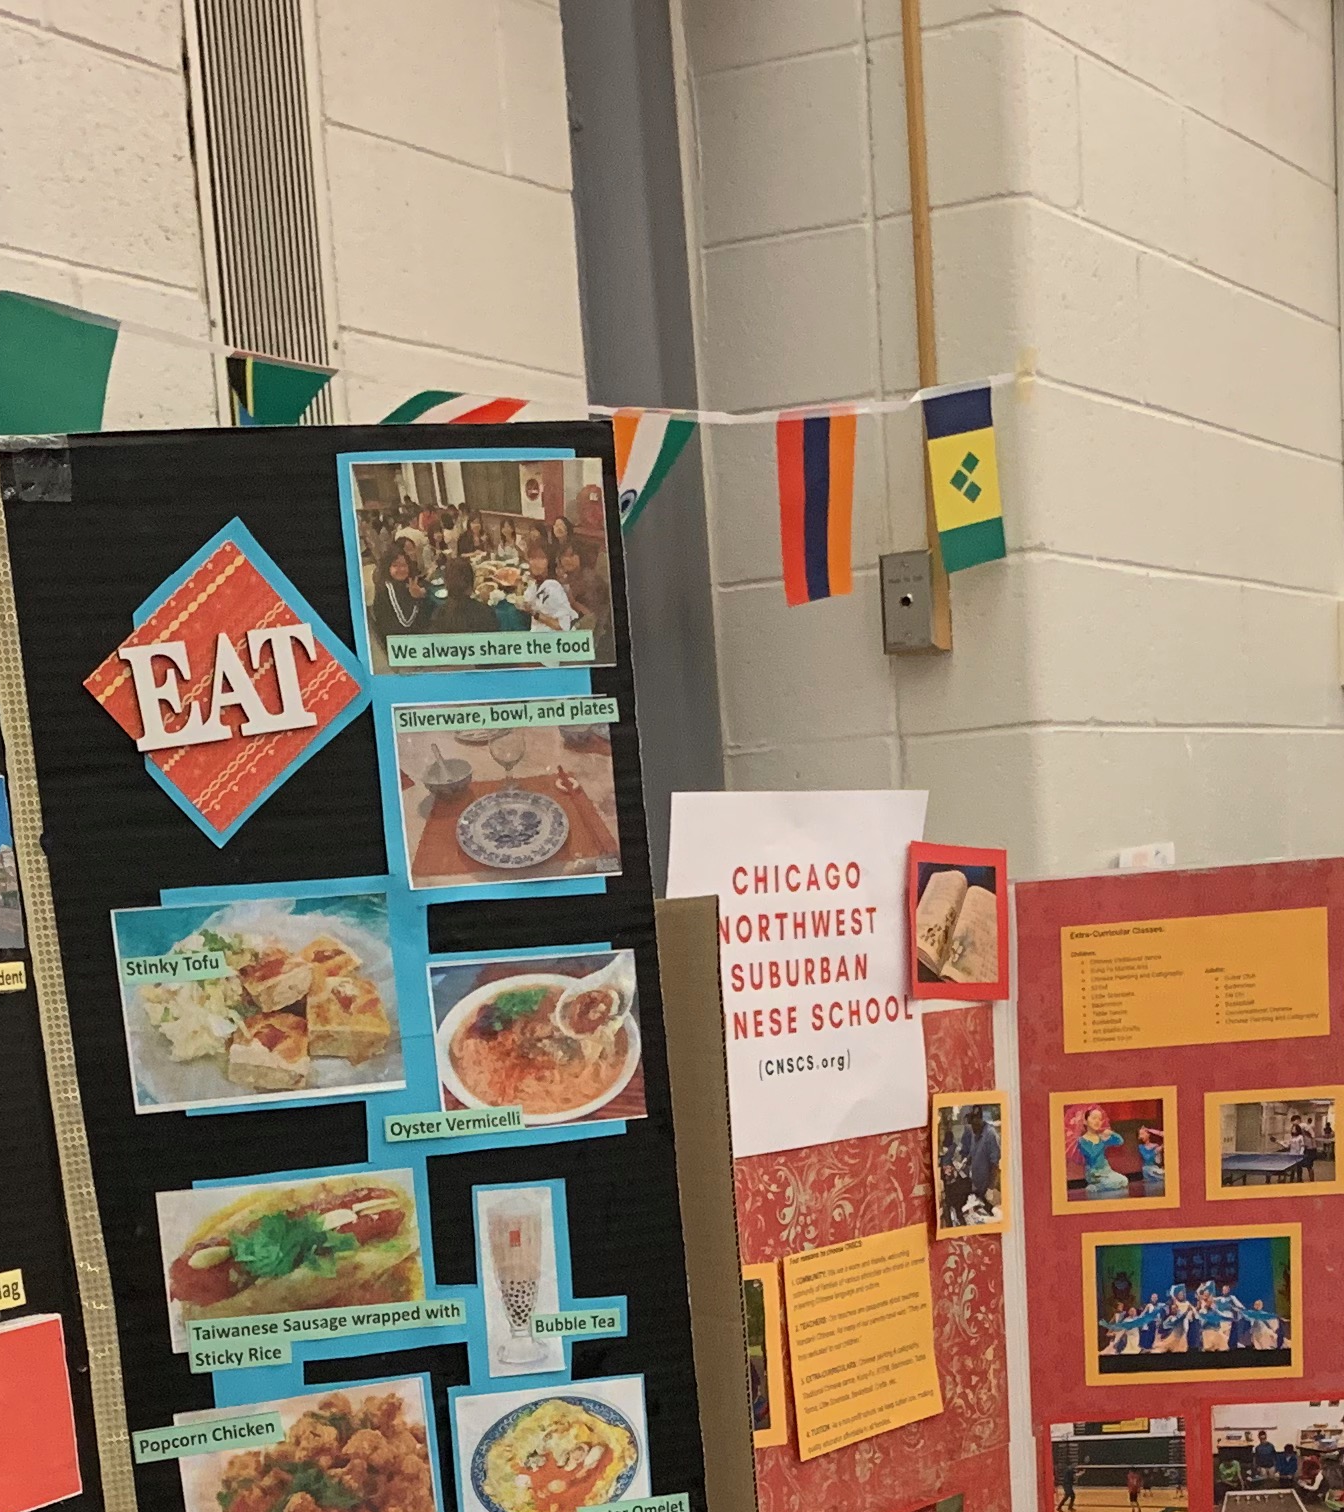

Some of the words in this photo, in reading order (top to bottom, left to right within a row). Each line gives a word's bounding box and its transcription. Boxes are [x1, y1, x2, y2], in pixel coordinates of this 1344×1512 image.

[390, 642, 418, 661] We
[421, 640, 476, 663] always
[479, 638, 522, 657] share
[526, 637, 552, 656] the
[556, 635, 591, 655] food
[118, 622, 318, 752] EAT
[398, 709, 486, 730] Silverware,
[490, 703, 533, 724] bowl,
[537, 702, 566, 720] and
[569, 700, 615, 722] plates
[732, 861, 862, 896] CHICAGO
[719, 906, 878, 945] NORTHWEST
[126, 955, 181, 978] Stinky
[184, 953, 220, 972] Tofu
[731, 953, 869, 992] SUBURBAN
[733, 1005, 797, 1041] NESE
[811, 994, 914, 1032] SCHOOL
[759, 1049, 851, 1081] (CNSCS.org)
[390, 1117, 443, 1142] Oyster
[445, 1109, 521, 1133] Vermicelli
[191, 1320, 280, 1343] Taiwanese
[283, 1314, 348, 1337] Sausage
[351, 1307, 422, 1330] wrapped
[424, 1303, 461, 1322] with
[534, 1315, 587, 1334] Bubble
[589, 1313, 616, 1331] Tea
[195, 1346, 244, 1369] Sticky
[248, 1344, 282, 1362] Rice
[139, 1430, 207, 1458] Popcorn
[210, 1418, 276, 1442] Chicken
